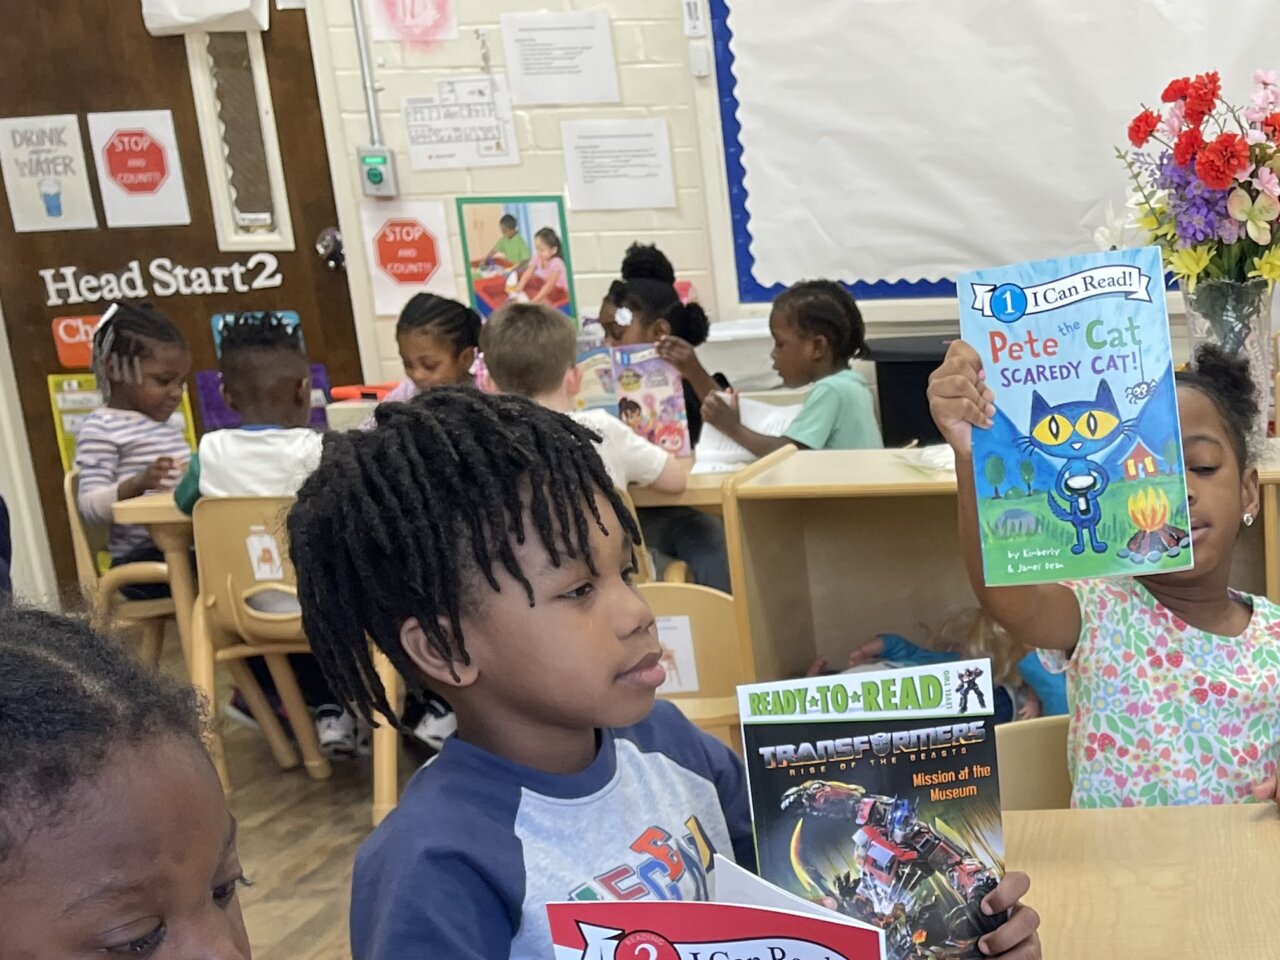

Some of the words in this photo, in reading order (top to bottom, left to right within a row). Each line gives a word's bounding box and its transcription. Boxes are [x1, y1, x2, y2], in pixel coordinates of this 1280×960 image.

[11, 126, 67, 148] DRINK
[113, 136, 150, 152] STOP
[14, 157, 77, 177] WATER
[384, 226, 423, 242] STOP
[39, 260, 148, 306] Head
[1002, 291, 1015, 314] 1
[1032, 292, 1040, 308] I
[1043, 285, 1079, 305] Can
[1082, 271, 1133, 292] Read!
[989, 330, 1058, 364] Pete
[1058, 321, 1080, 337] the
[1086, 316, 1142, 350] Cat
[1000, 360, 1081, 388] SCAREDY
[1091, 352, 1137, 375] CAT!
[1008, 550, 1019, 559] by
[1023, 548, 1060, 557] Kimberly
[1017, 564, 1041, 573] James
[1045, 562, 1064, 570] Dean
[749, 687, 808, 716] READY
[817, 683, 849, 714] TO
[861, 674, 943, 712] READ
[789, 766, 827, 776] RISE
[840, 761, 856, 771] OF
[869, 756, 897, 765] THE
[910, 748, 968, 762] BEASTS
[912, 770, 955, 788] Mission
[958, 767, 969, 781] at
[973, 765, 991, 778] the
[930, 786, 977, 801] Museum
